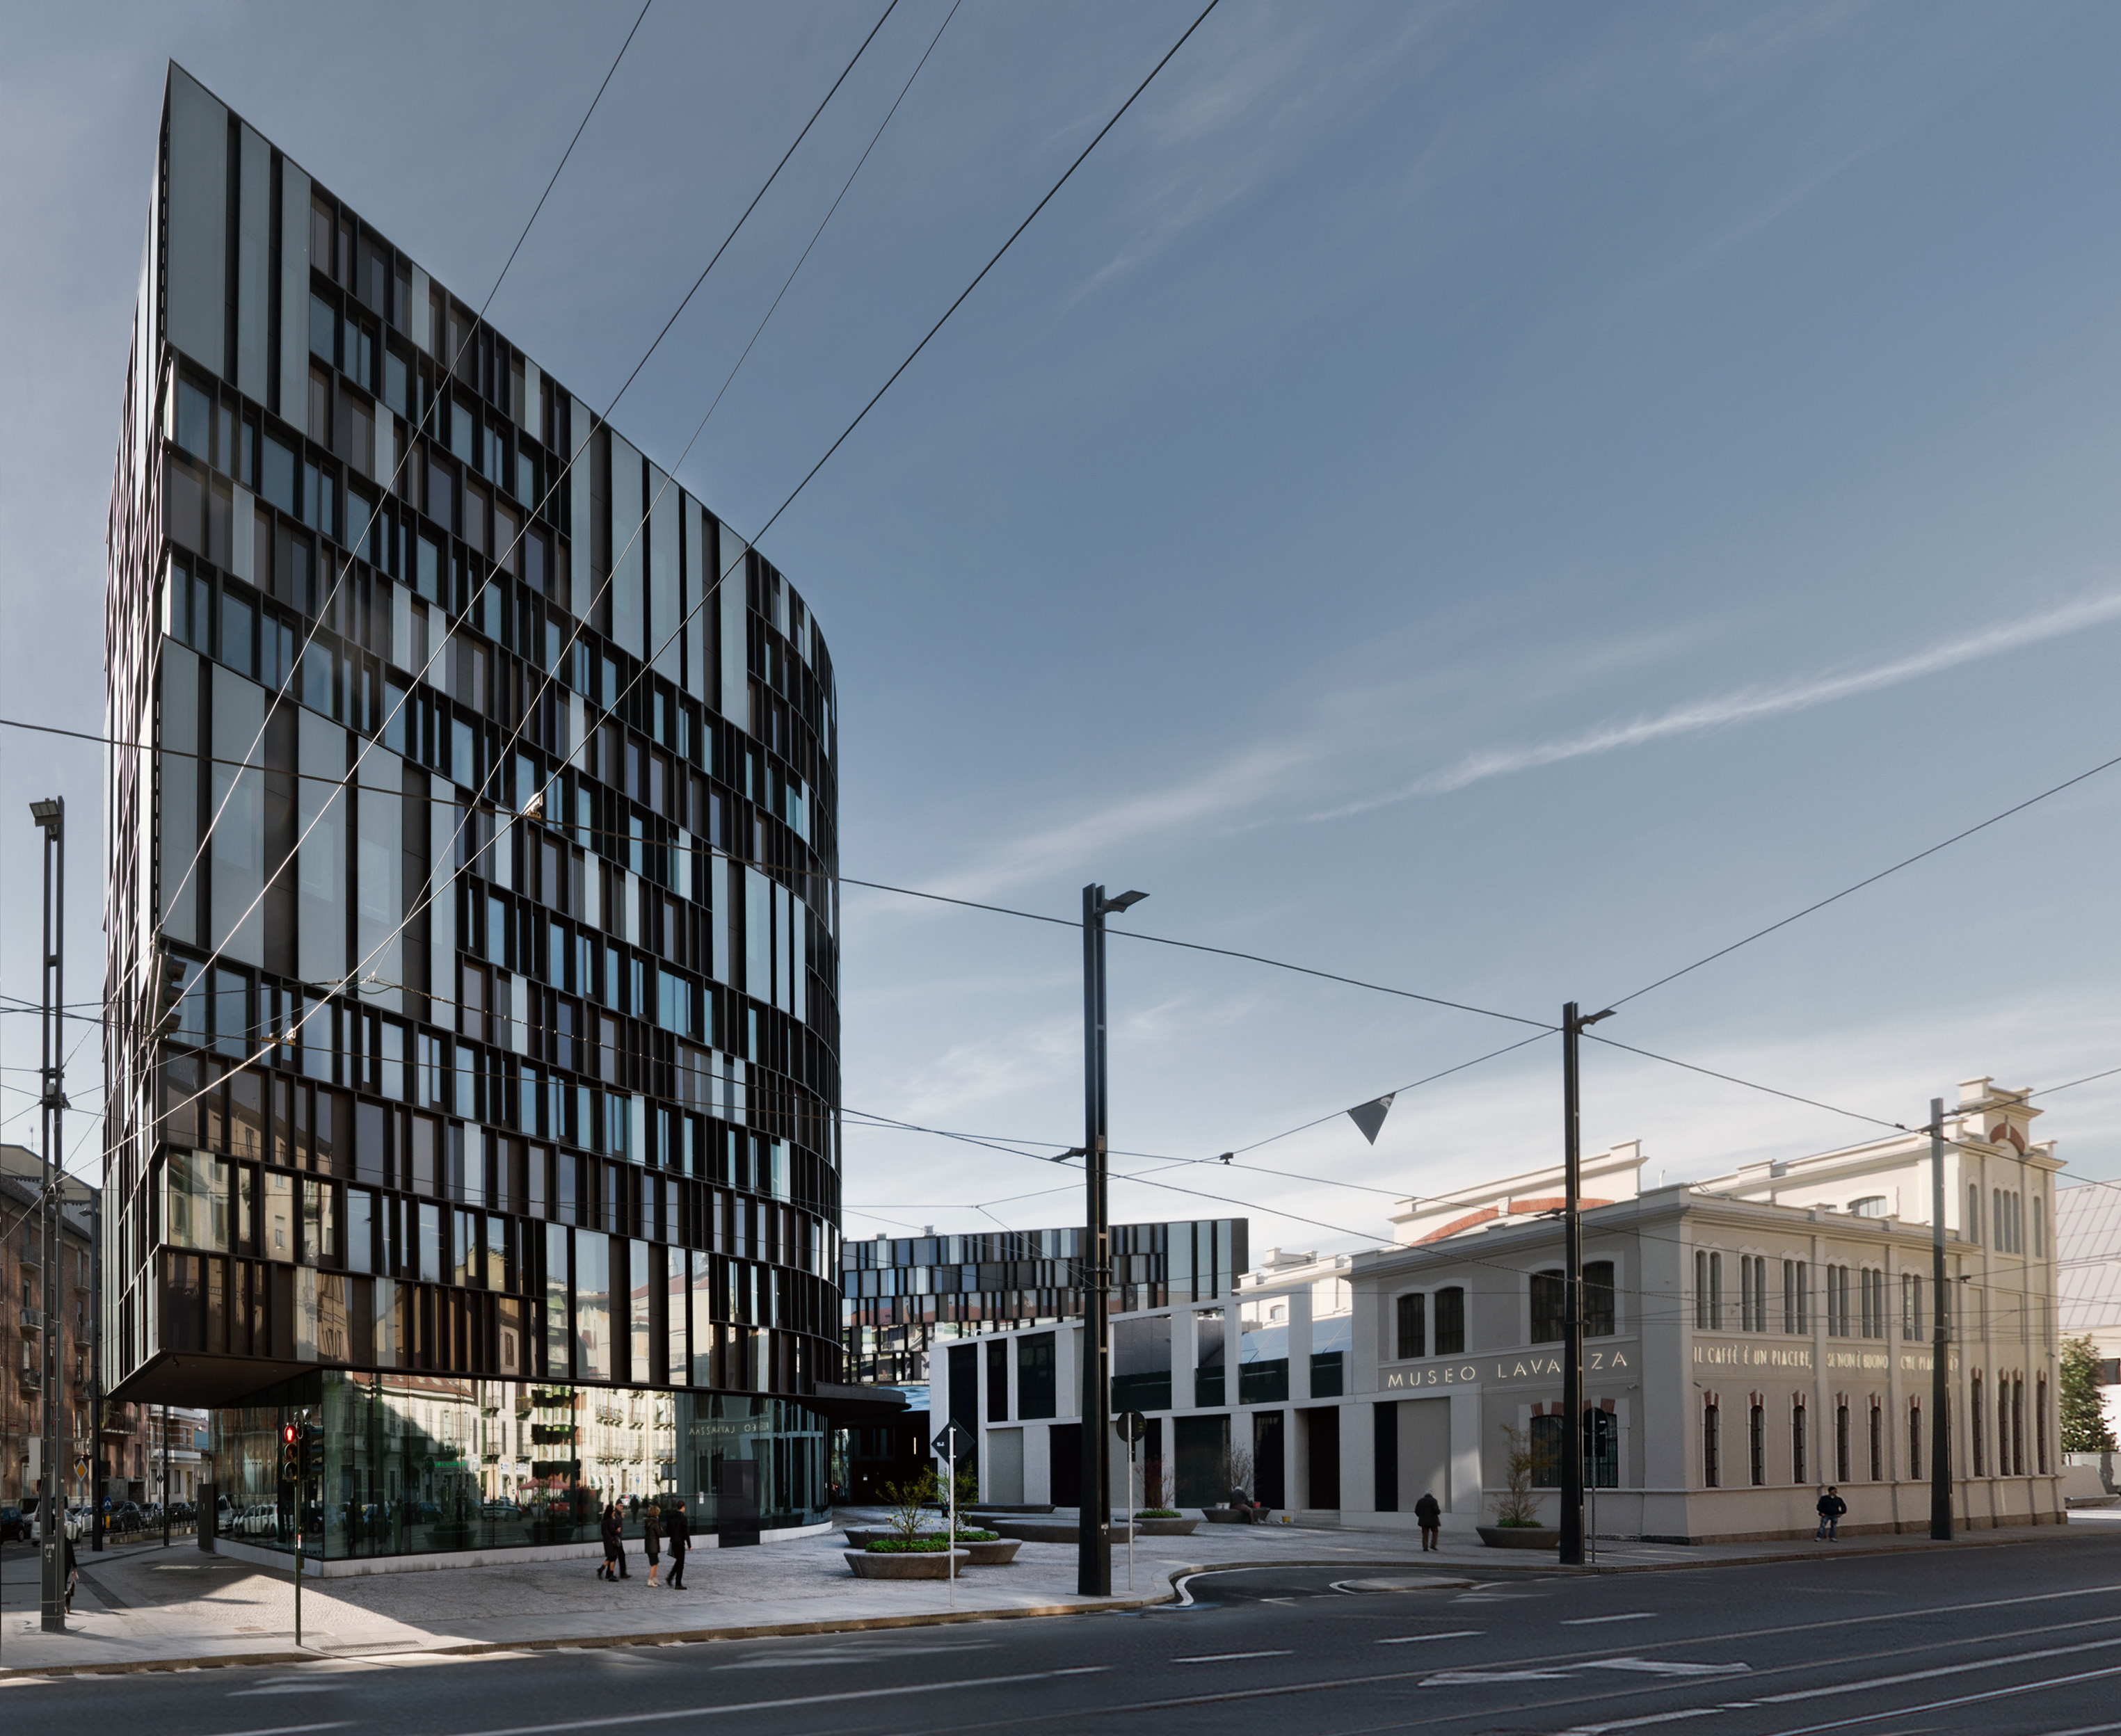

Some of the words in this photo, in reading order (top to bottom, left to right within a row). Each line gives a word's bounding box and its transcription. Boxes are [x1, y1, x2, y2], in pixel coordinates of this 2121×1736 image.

[1693, 1347, 1703, 1363] IL
[1708, 1344, 1738, 1365] CAFFÈ
[1754, 1350, 1767, 1365] UN
[1388, 1366, 1475, 1388] MUSEO
[1498, 1351, 1628, 1379] LAVAZA
